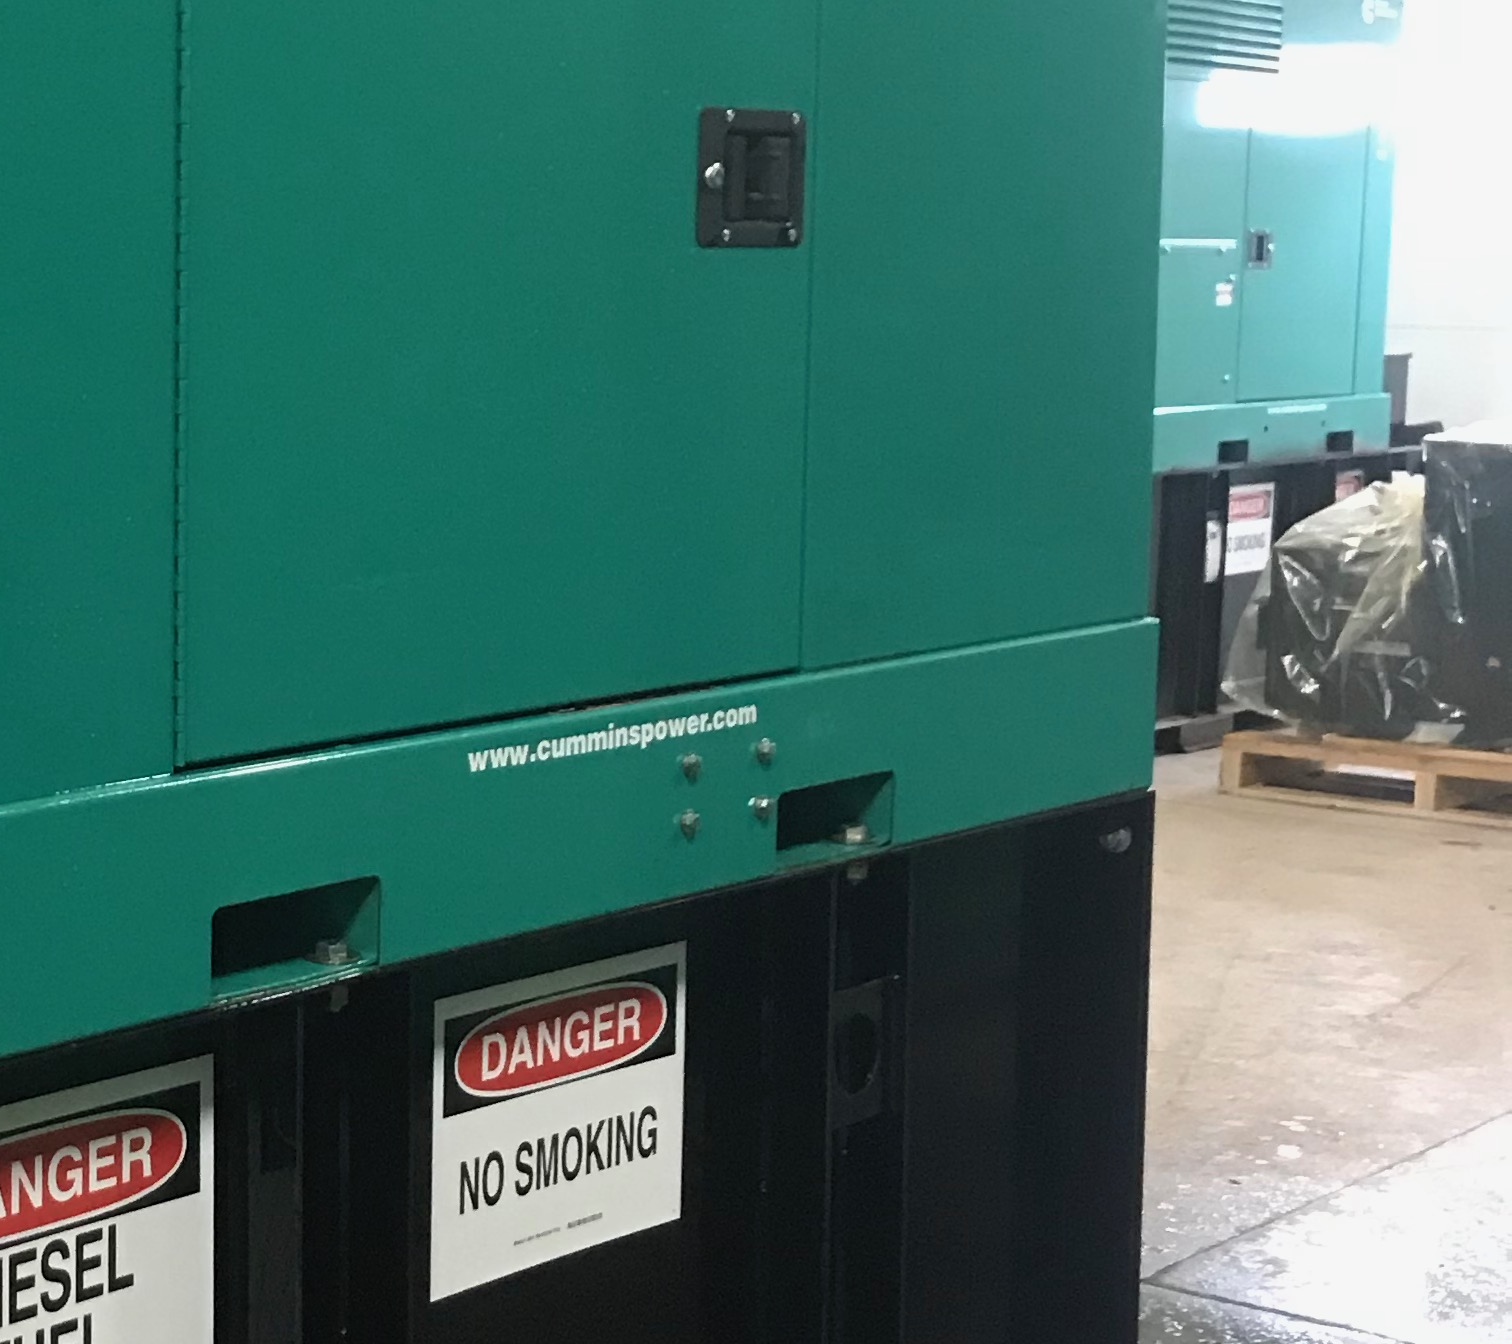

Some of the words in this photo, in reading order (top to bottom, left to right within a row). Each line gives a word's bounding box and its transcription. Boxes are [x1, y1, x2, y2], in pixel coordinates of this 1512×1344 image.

[468, 703, 758, 773] www.cumminspower.com
[481, 998, 642, 1082] DANGER
[459, 1150, 504, 1215] NO
[514, 1105, 658, 1196] SMOKING
